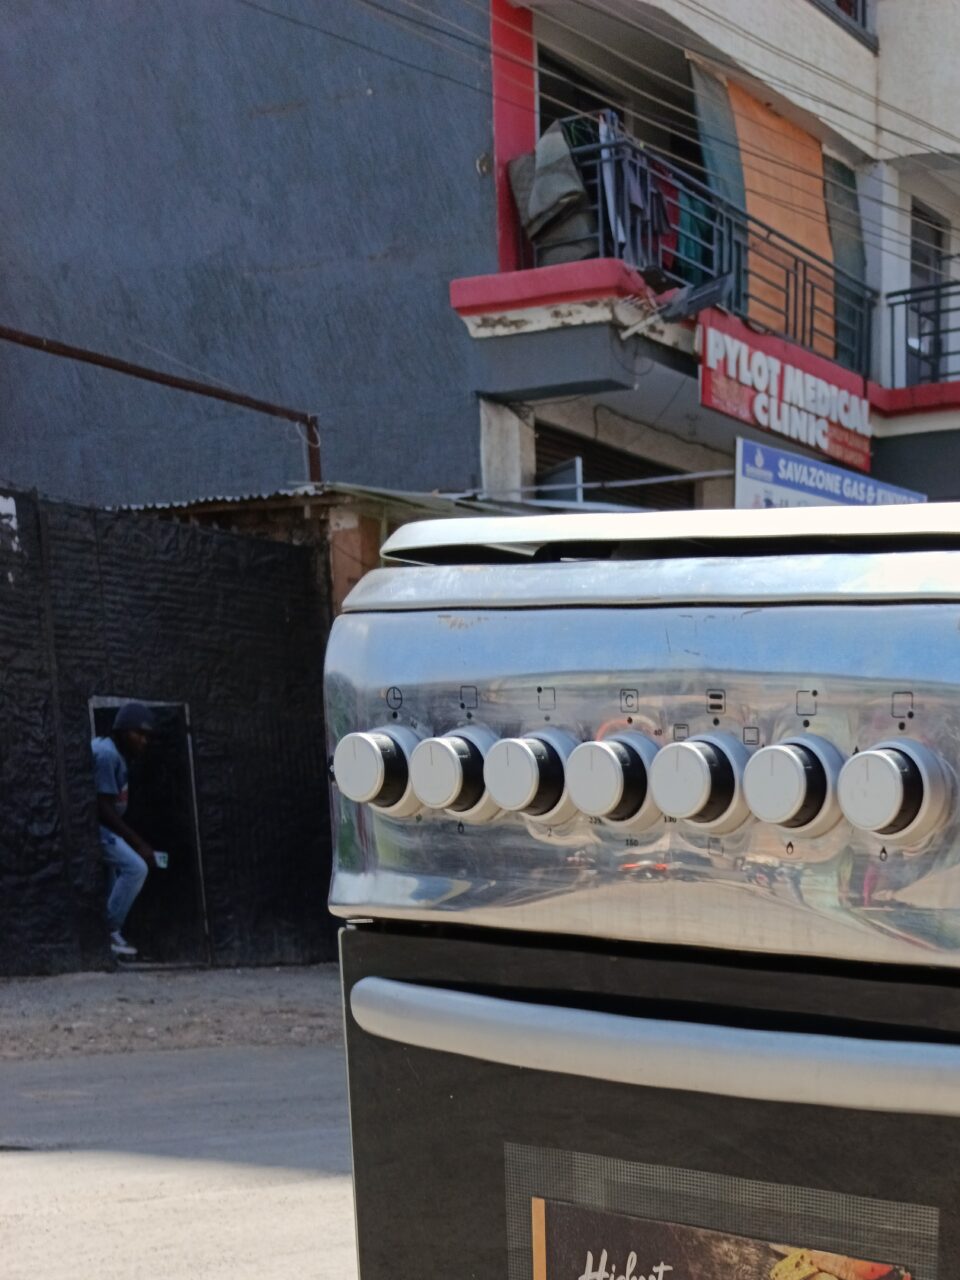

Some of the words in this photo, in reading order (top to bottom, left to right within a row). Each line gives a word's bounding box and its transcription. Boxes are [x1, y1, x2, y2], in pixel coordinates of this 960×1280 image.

[706, 327, 781, 401] PYLOT
[783, 364, 872, 437] MEDICAL
[753, 393, 829, 450] CLINIC
[843, 477, 866, 501] GAS
